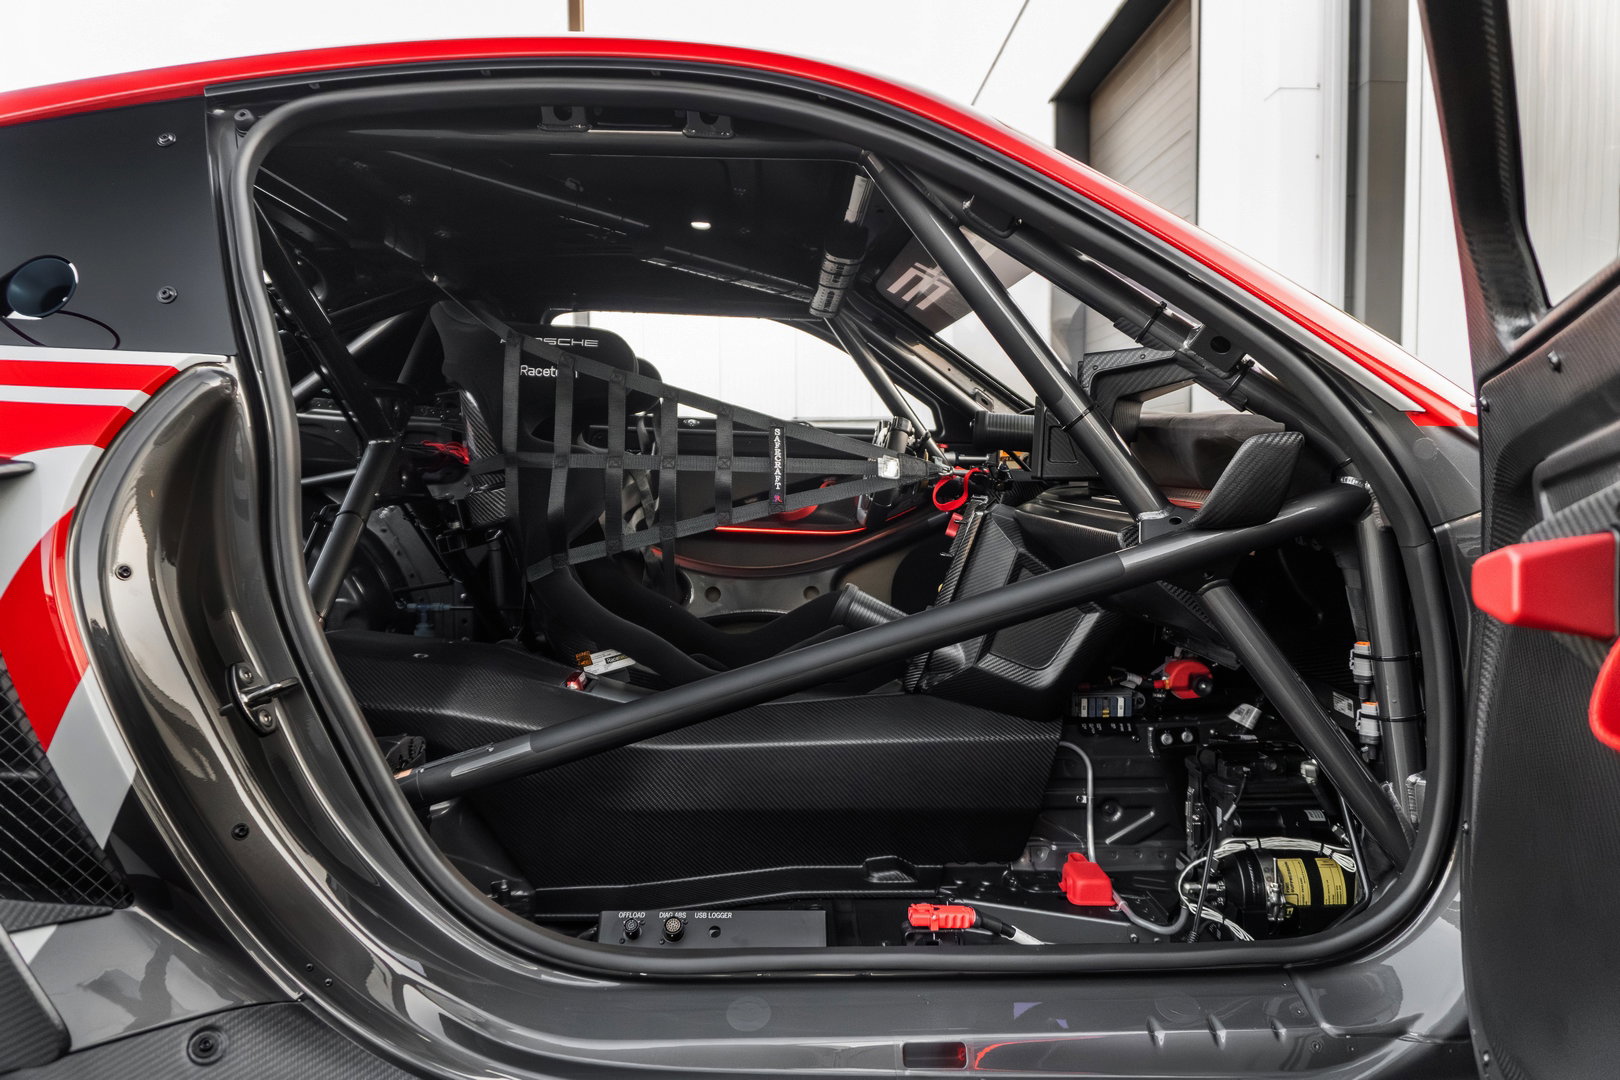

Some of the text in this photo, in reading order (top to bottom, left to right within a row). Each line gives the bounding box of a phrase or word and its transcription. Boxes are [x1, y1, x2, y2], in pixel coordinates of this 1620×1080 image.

[500, 337, 599, 347] SCHE
[520, 364, 578, 378] Racet
[773, 428, 782, 490] SAFECRAFT
[618, 911, 646, 919] OFFLOAD
[694, 911, 733, 919] USB LOGGER
